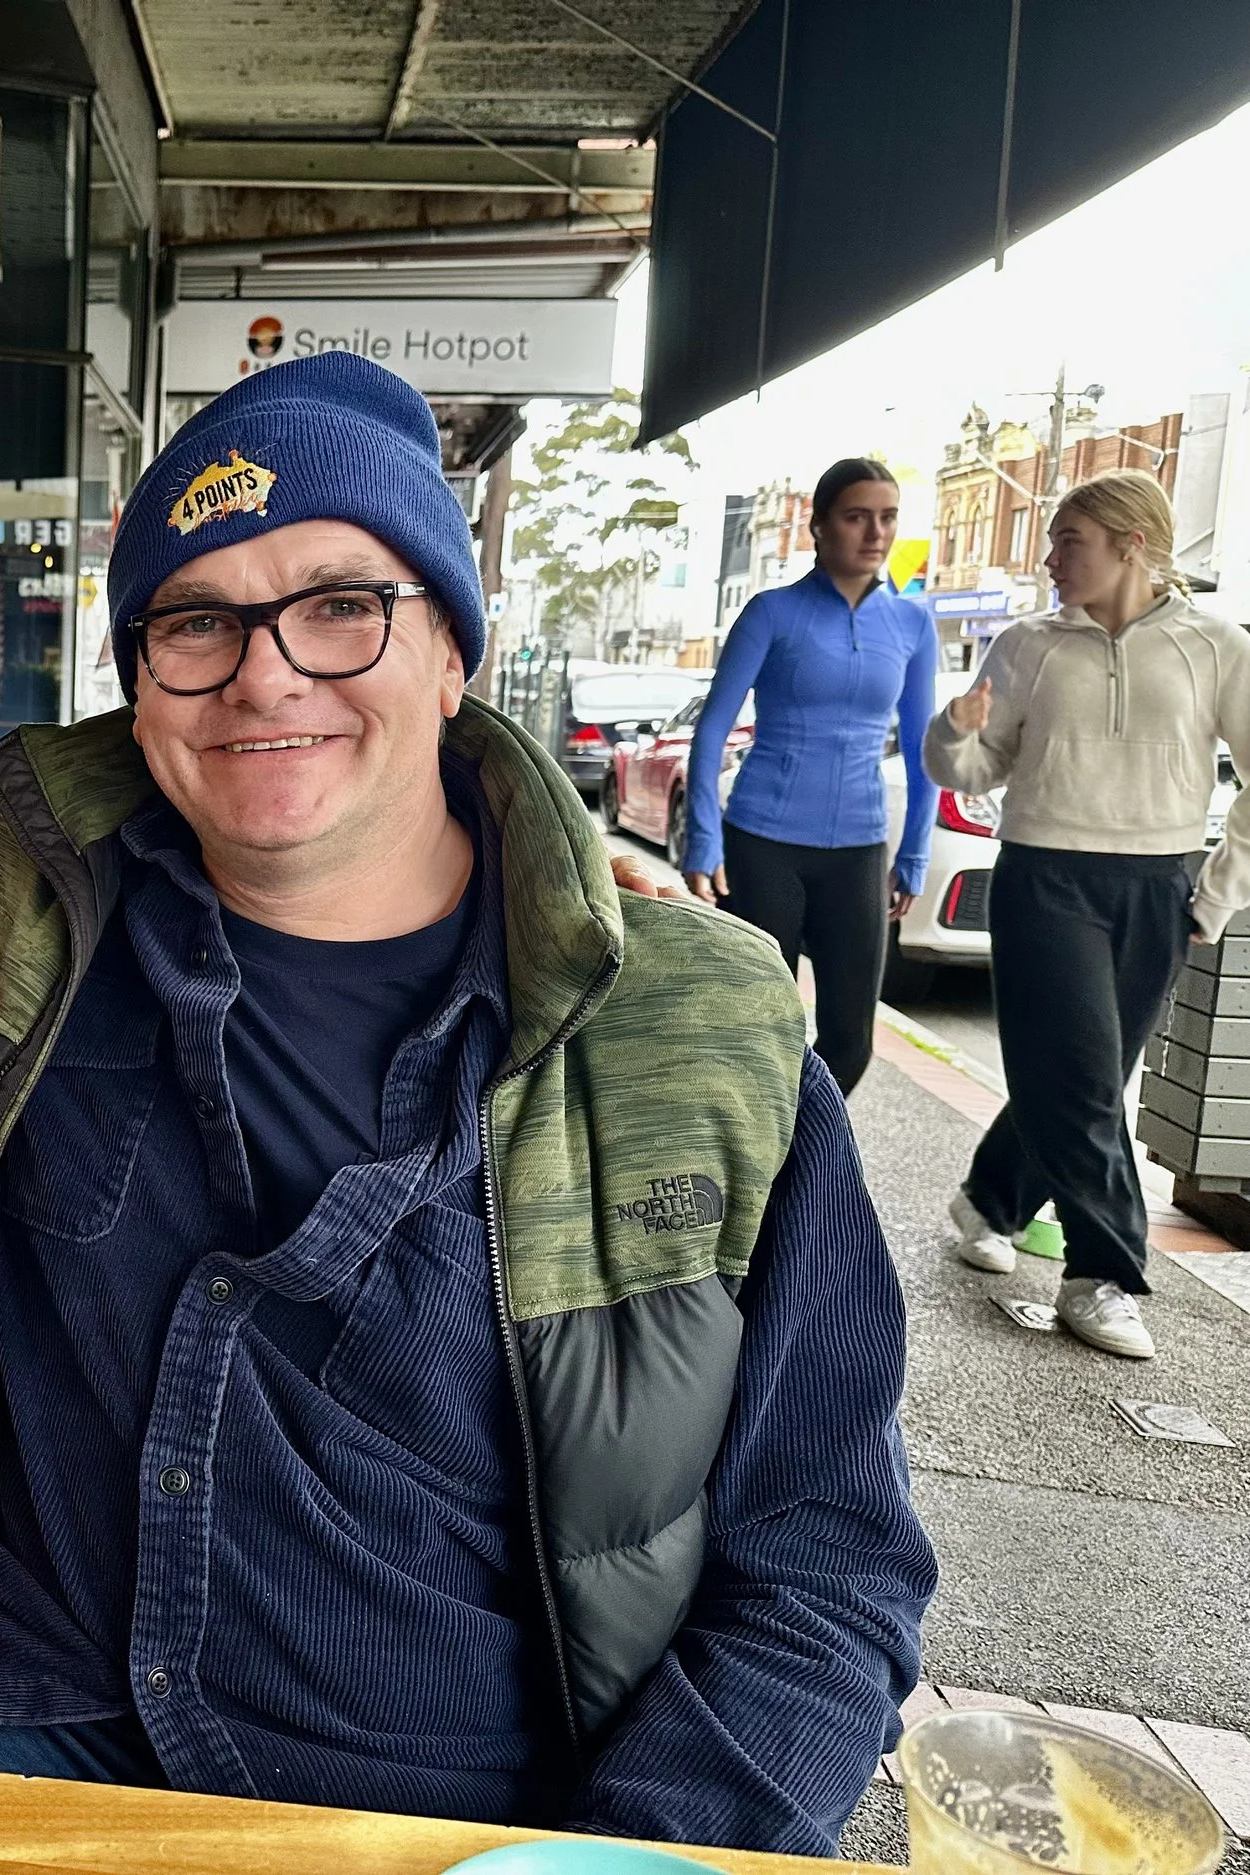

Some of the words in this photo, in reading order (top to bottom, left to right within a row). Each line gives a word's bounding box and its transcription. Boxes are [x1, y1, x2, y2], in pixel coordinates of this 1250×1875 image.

[293, 326, 391, 358] Smile
[403, 329, 529, 368] Hotpot
[182, 498, 194, 520] 4
[194, 467, 258, 514] POINTS
[646, 1174, 692, 1197] THE
[617, 1191, 696, 1221] NORTH
[641, 1210, 699, 1235] FACE
